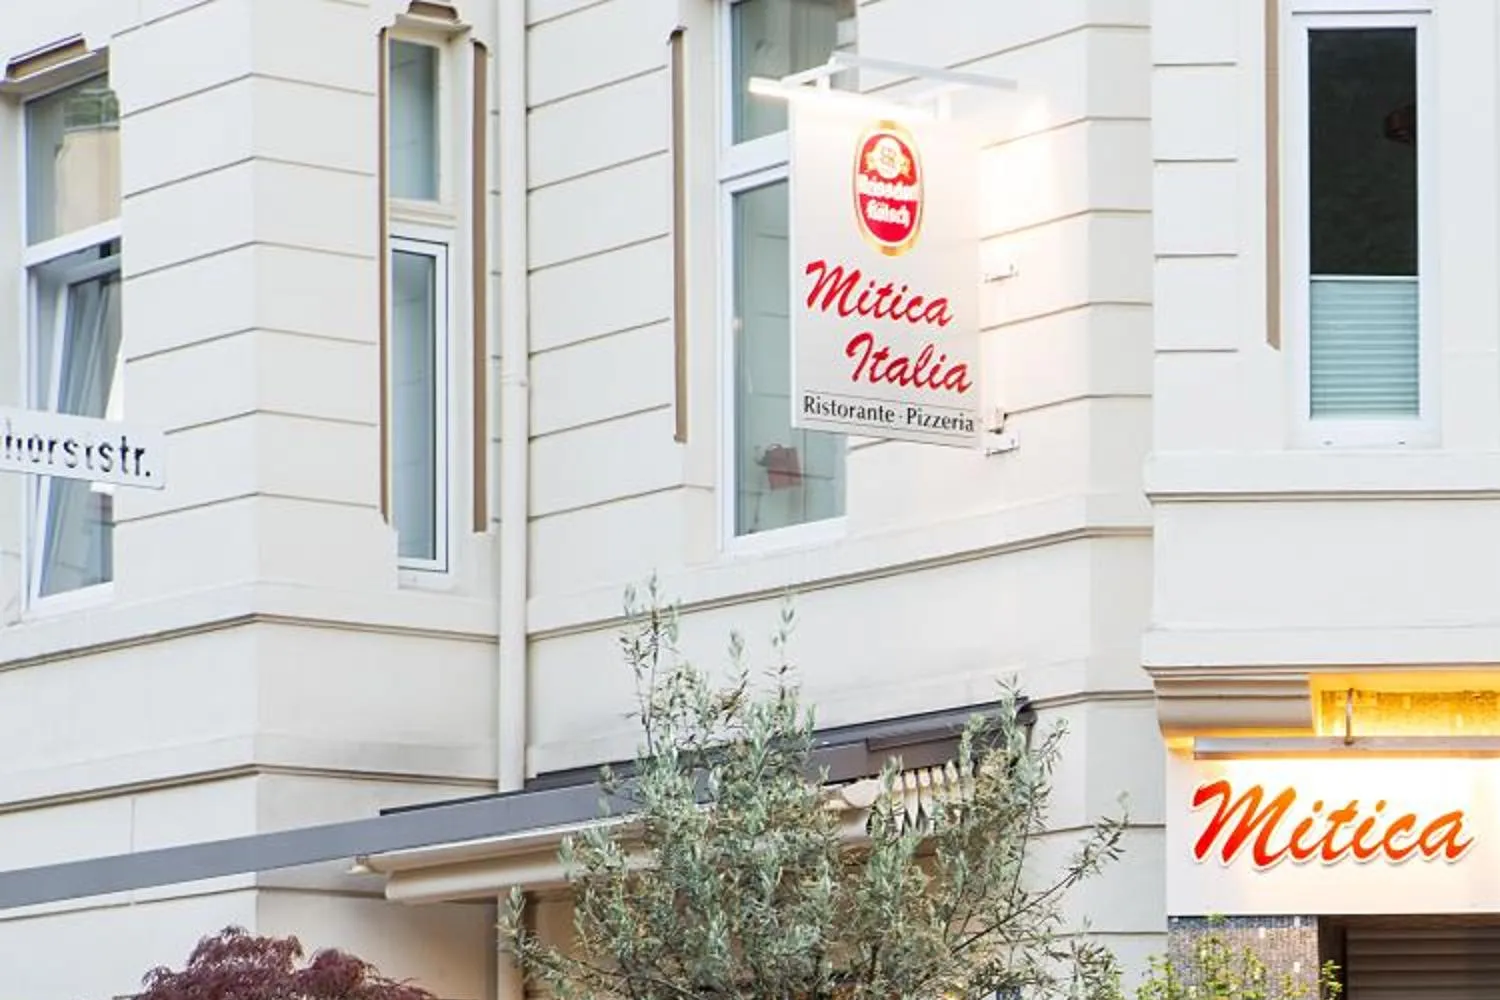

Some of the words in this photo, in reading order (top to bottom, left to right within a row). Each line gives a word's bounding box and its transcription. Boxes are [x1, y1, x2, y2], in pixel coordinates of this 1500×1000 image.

[805, 259, 952, 327] Mitica
[845, 331, 973, 393] Italia
[803, 395, 896, 423] Ristorante
[906, 407, 975, 433] Pizzeria
[0, 417, 151, 477] horststr.
[1192, 779, 1473, 868] Mitica
